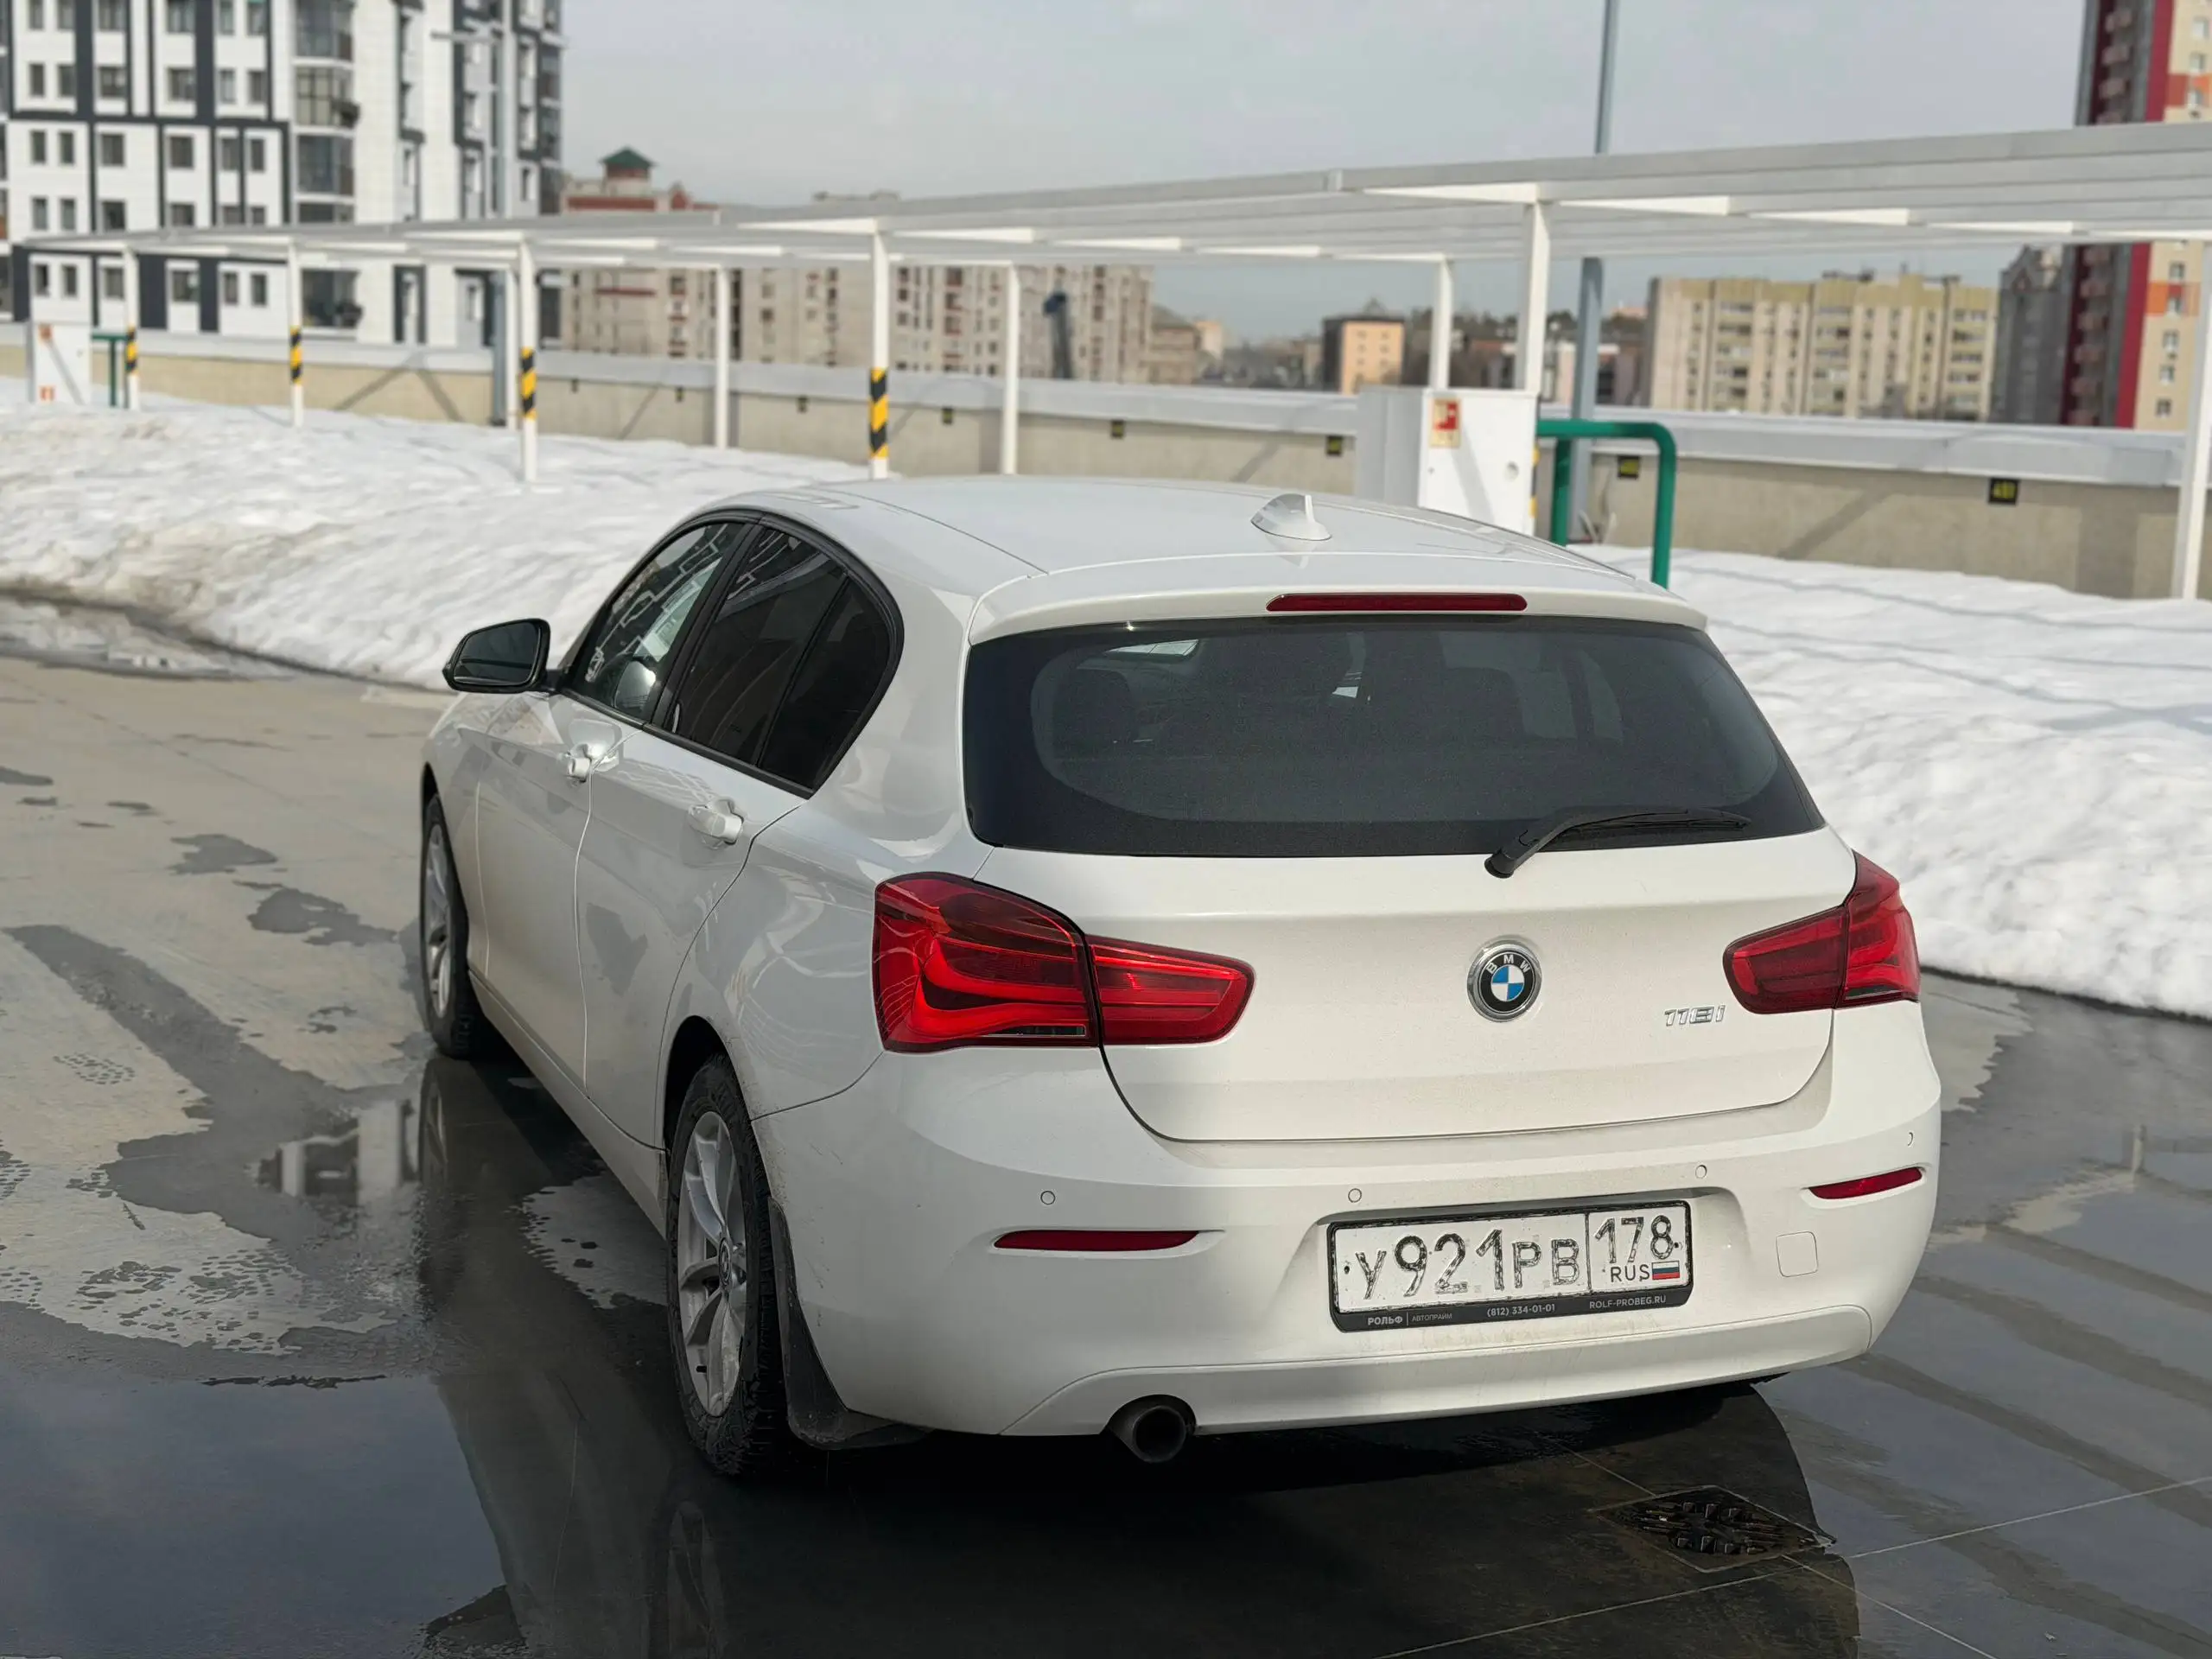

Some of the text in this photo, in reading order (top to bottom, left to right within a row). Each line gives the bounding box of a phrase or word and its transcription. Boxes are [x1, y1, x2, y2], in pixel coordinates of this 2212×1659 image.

[1485, 954, 1530, 975] BMW
[1664, 1005, 1726, 1027] 118i
[1594, 1215, 1674, 1264] 178
[1610, 1263, 1650, 1283] RUS
[1487, 1303, 1555, 1318] (812) 334-01-01
[1589, 1295, 1667, 1310] ROLF-PROBEG.RU
[1367, 1316, 1403, 1325] РОЛЬФ
